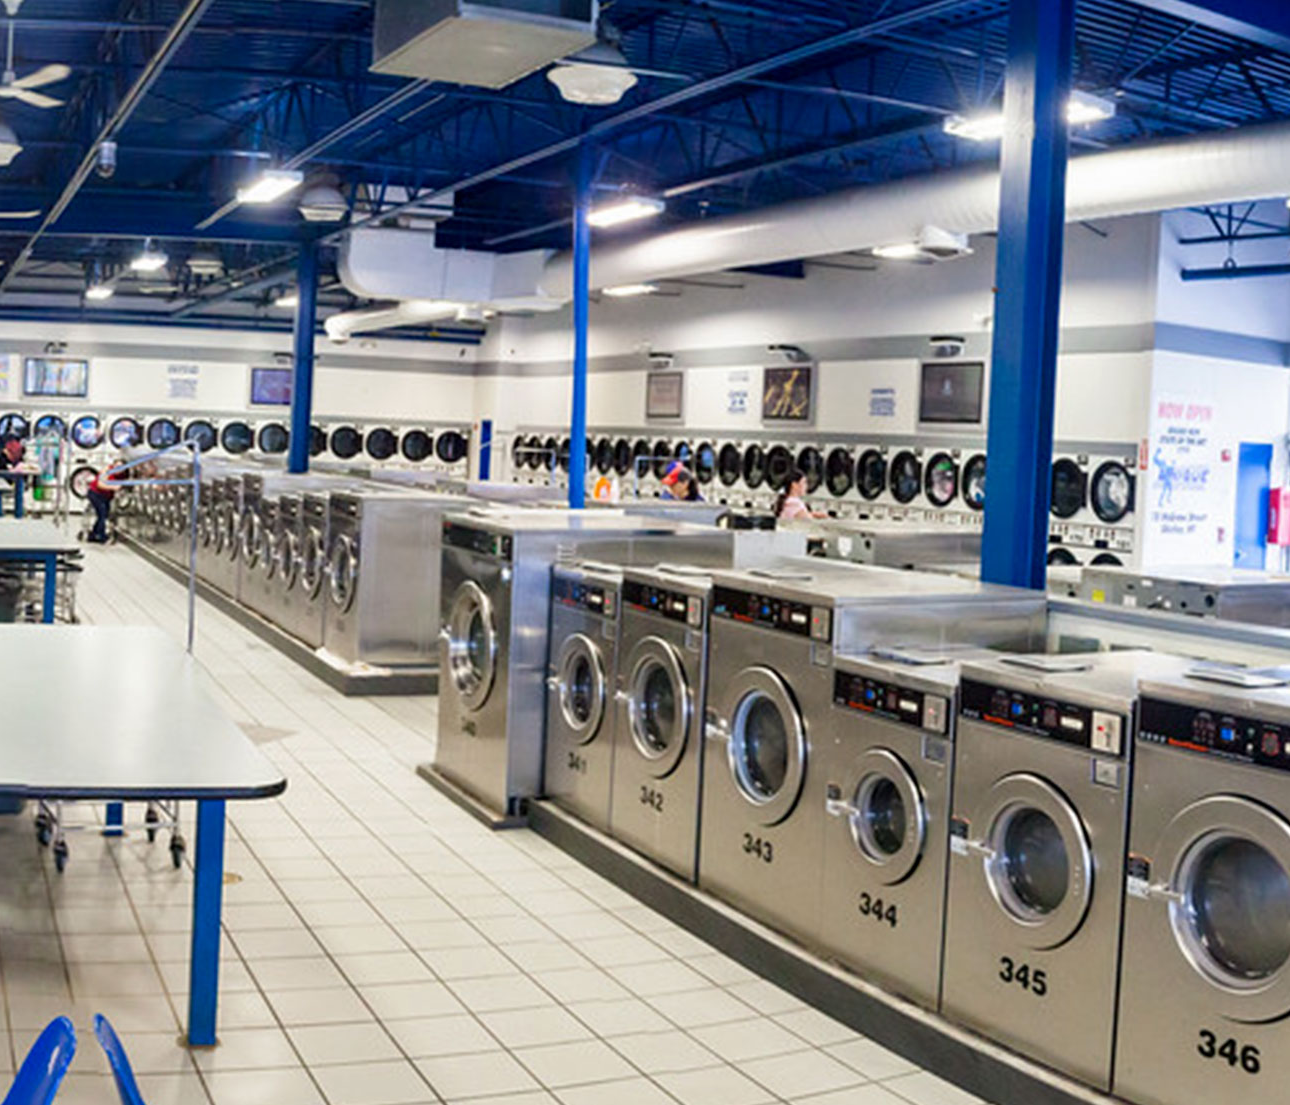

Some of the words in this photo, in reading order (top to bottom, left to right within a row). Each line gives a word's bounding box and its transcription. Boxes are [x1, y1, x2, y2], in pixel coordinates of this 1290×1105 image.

[567, 751, 588, 776] 341
[640, 785, 664, 813] 342
[743, 832, 773, 864] 343
[858, 892, 898, 928] 344
[998, 957, 1049, 997] 345
[1197, 1030, 1262, 1075] 346
